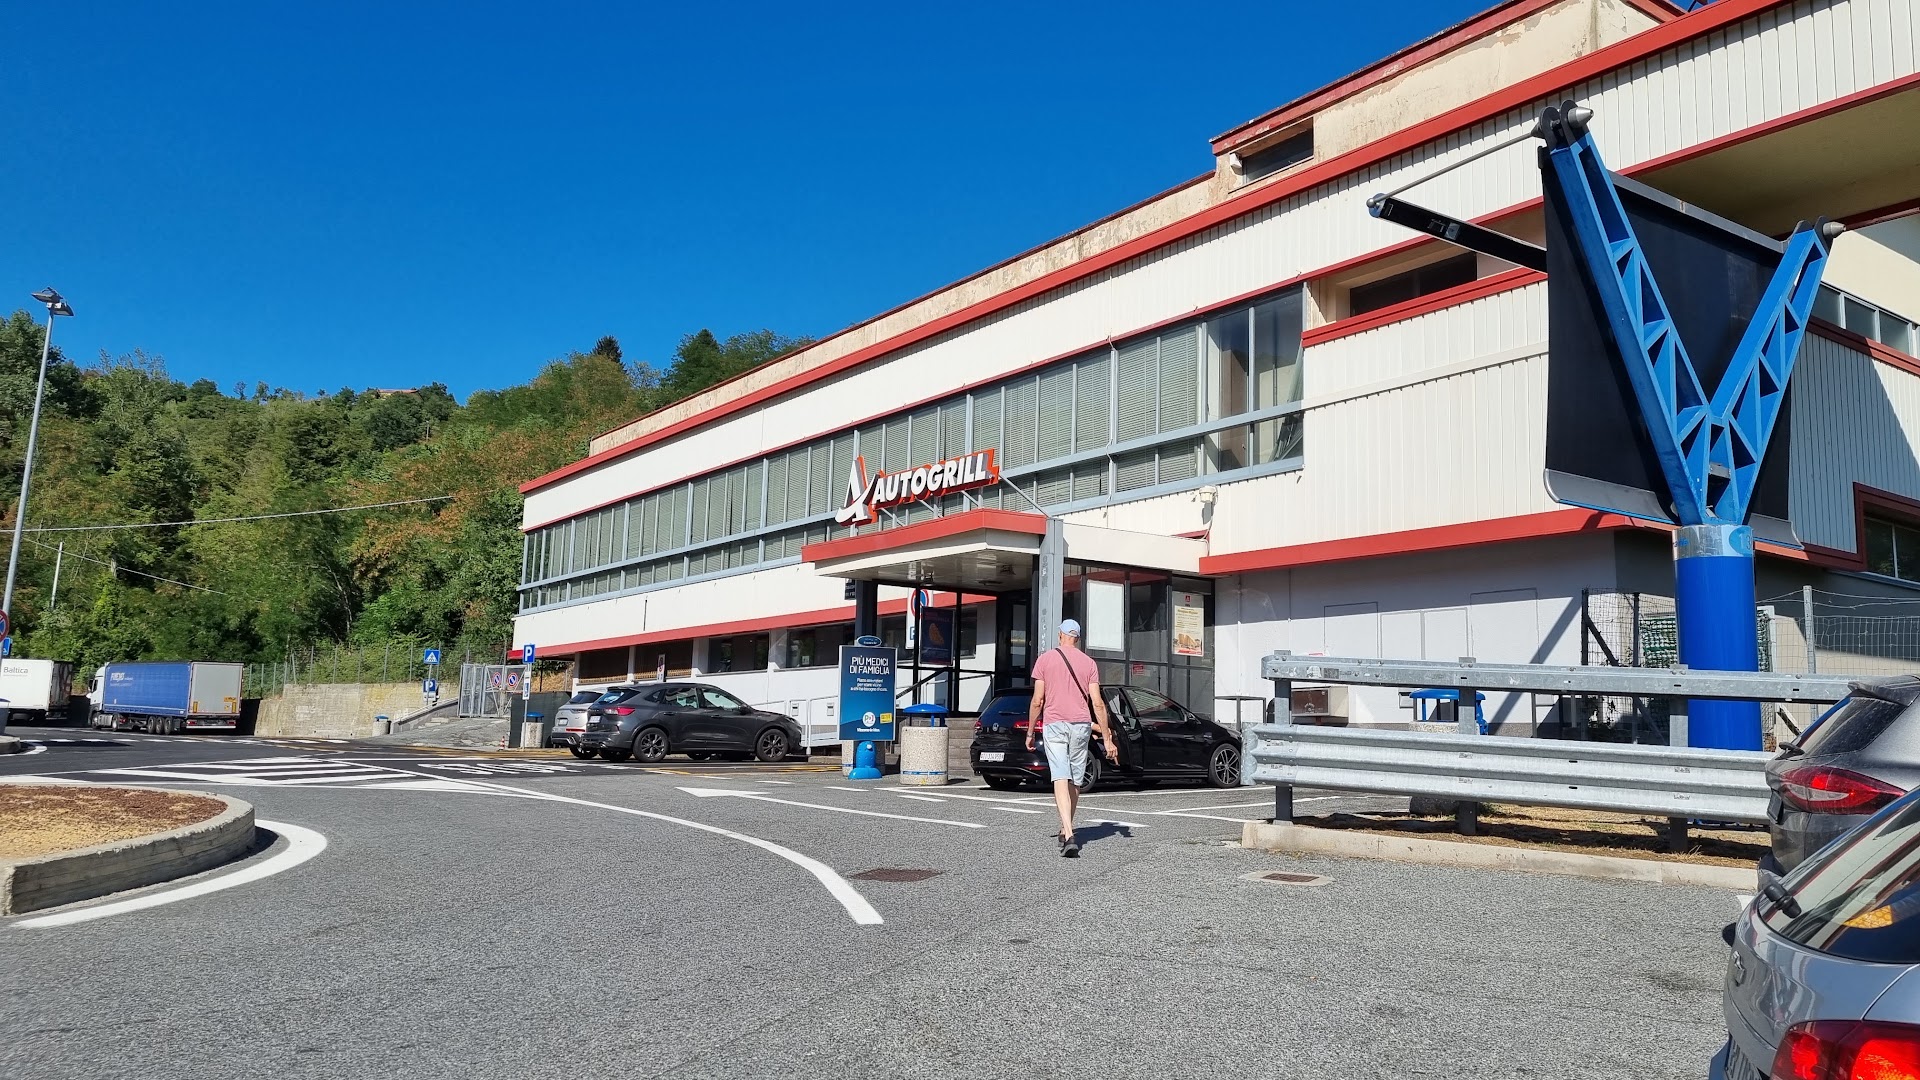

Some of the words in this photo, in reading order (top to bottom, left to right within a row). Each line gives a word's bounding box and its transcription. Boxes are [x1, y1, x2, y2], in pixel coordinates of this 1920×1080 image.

[873, 452, 987, 503] AUTOGRILL
[525, 646, 532, 661] P
[851, 655, 864, 665] PIÙ
[866, 657, 888, 666] MEDICI
[3, 666, 28, 674] Baltica
[850, 666, 857, 674] DI
[858, 666, 889, 675] FAMIGLIA
